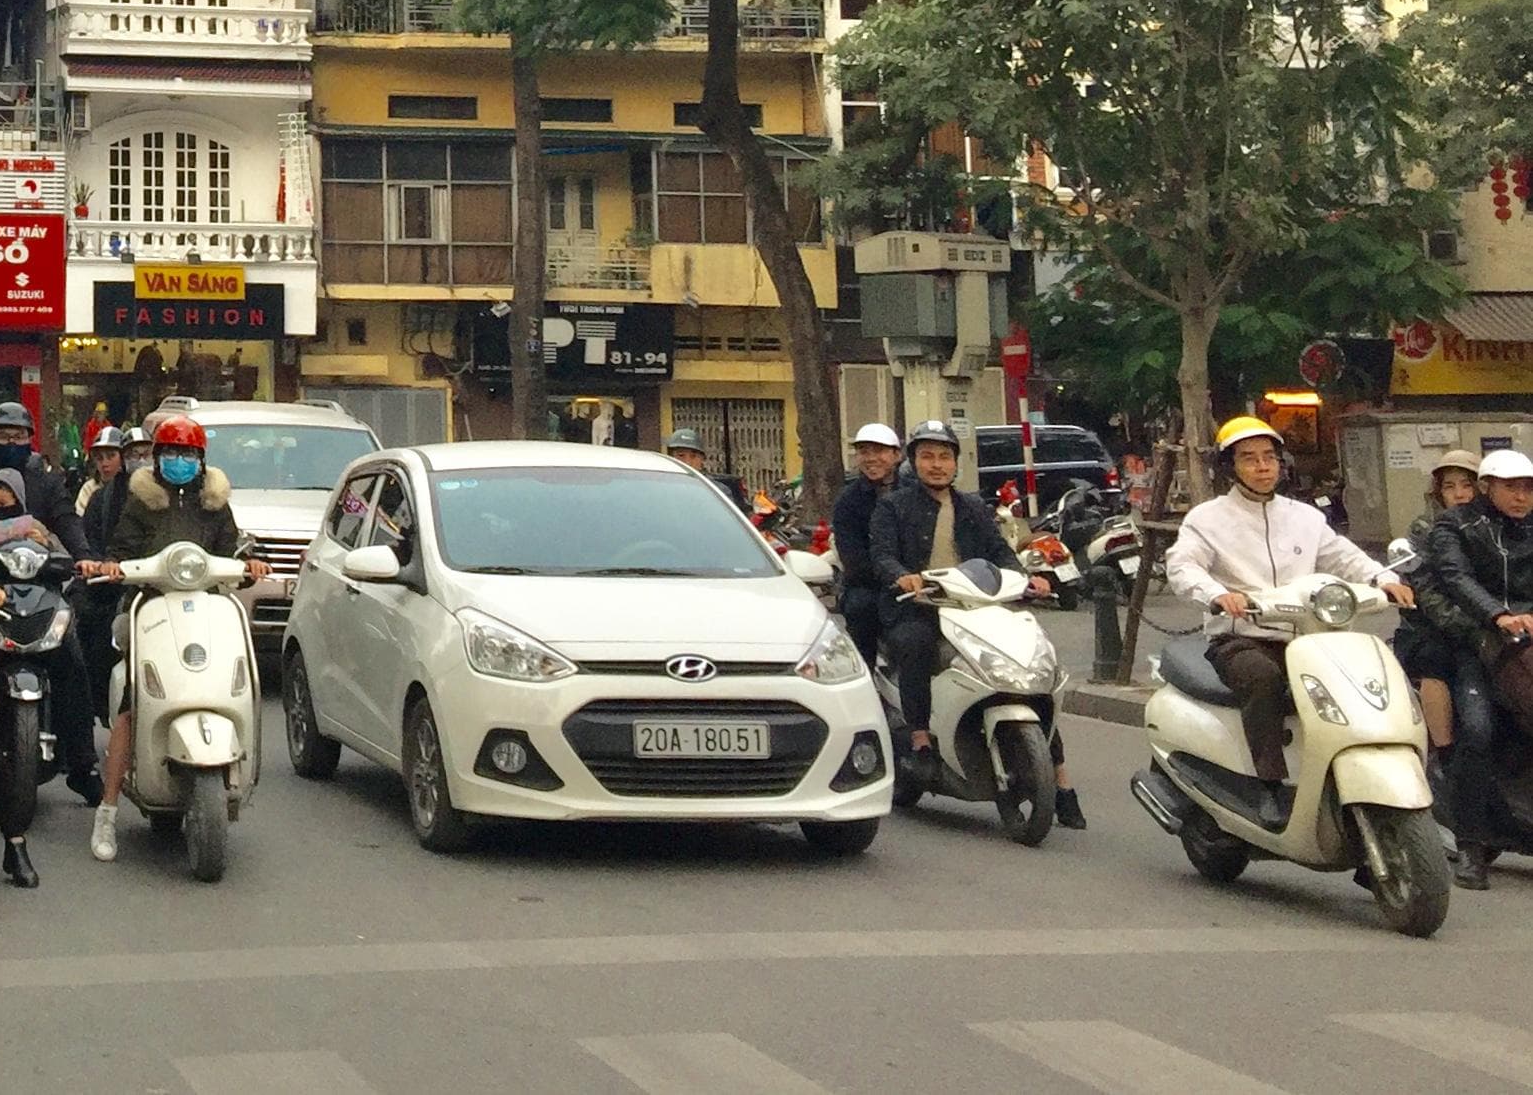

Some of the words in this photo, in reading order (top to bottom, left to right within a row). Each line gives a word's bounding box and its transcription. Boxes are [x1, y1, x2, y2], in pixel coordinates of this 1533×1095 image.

[19, 224, 48, 238] MÁY
[143, 272, 181, 293] VĂN
[187, 271, 238, 294] SÁNG
[7, 289, 44, 299] SUZUKI
[116, 308, 265, 326] FASHION
[609, 351, 632, 364] 81
[643, 352, 667, 365] 94
[640, 727, 762, 753] 20A-180.51
